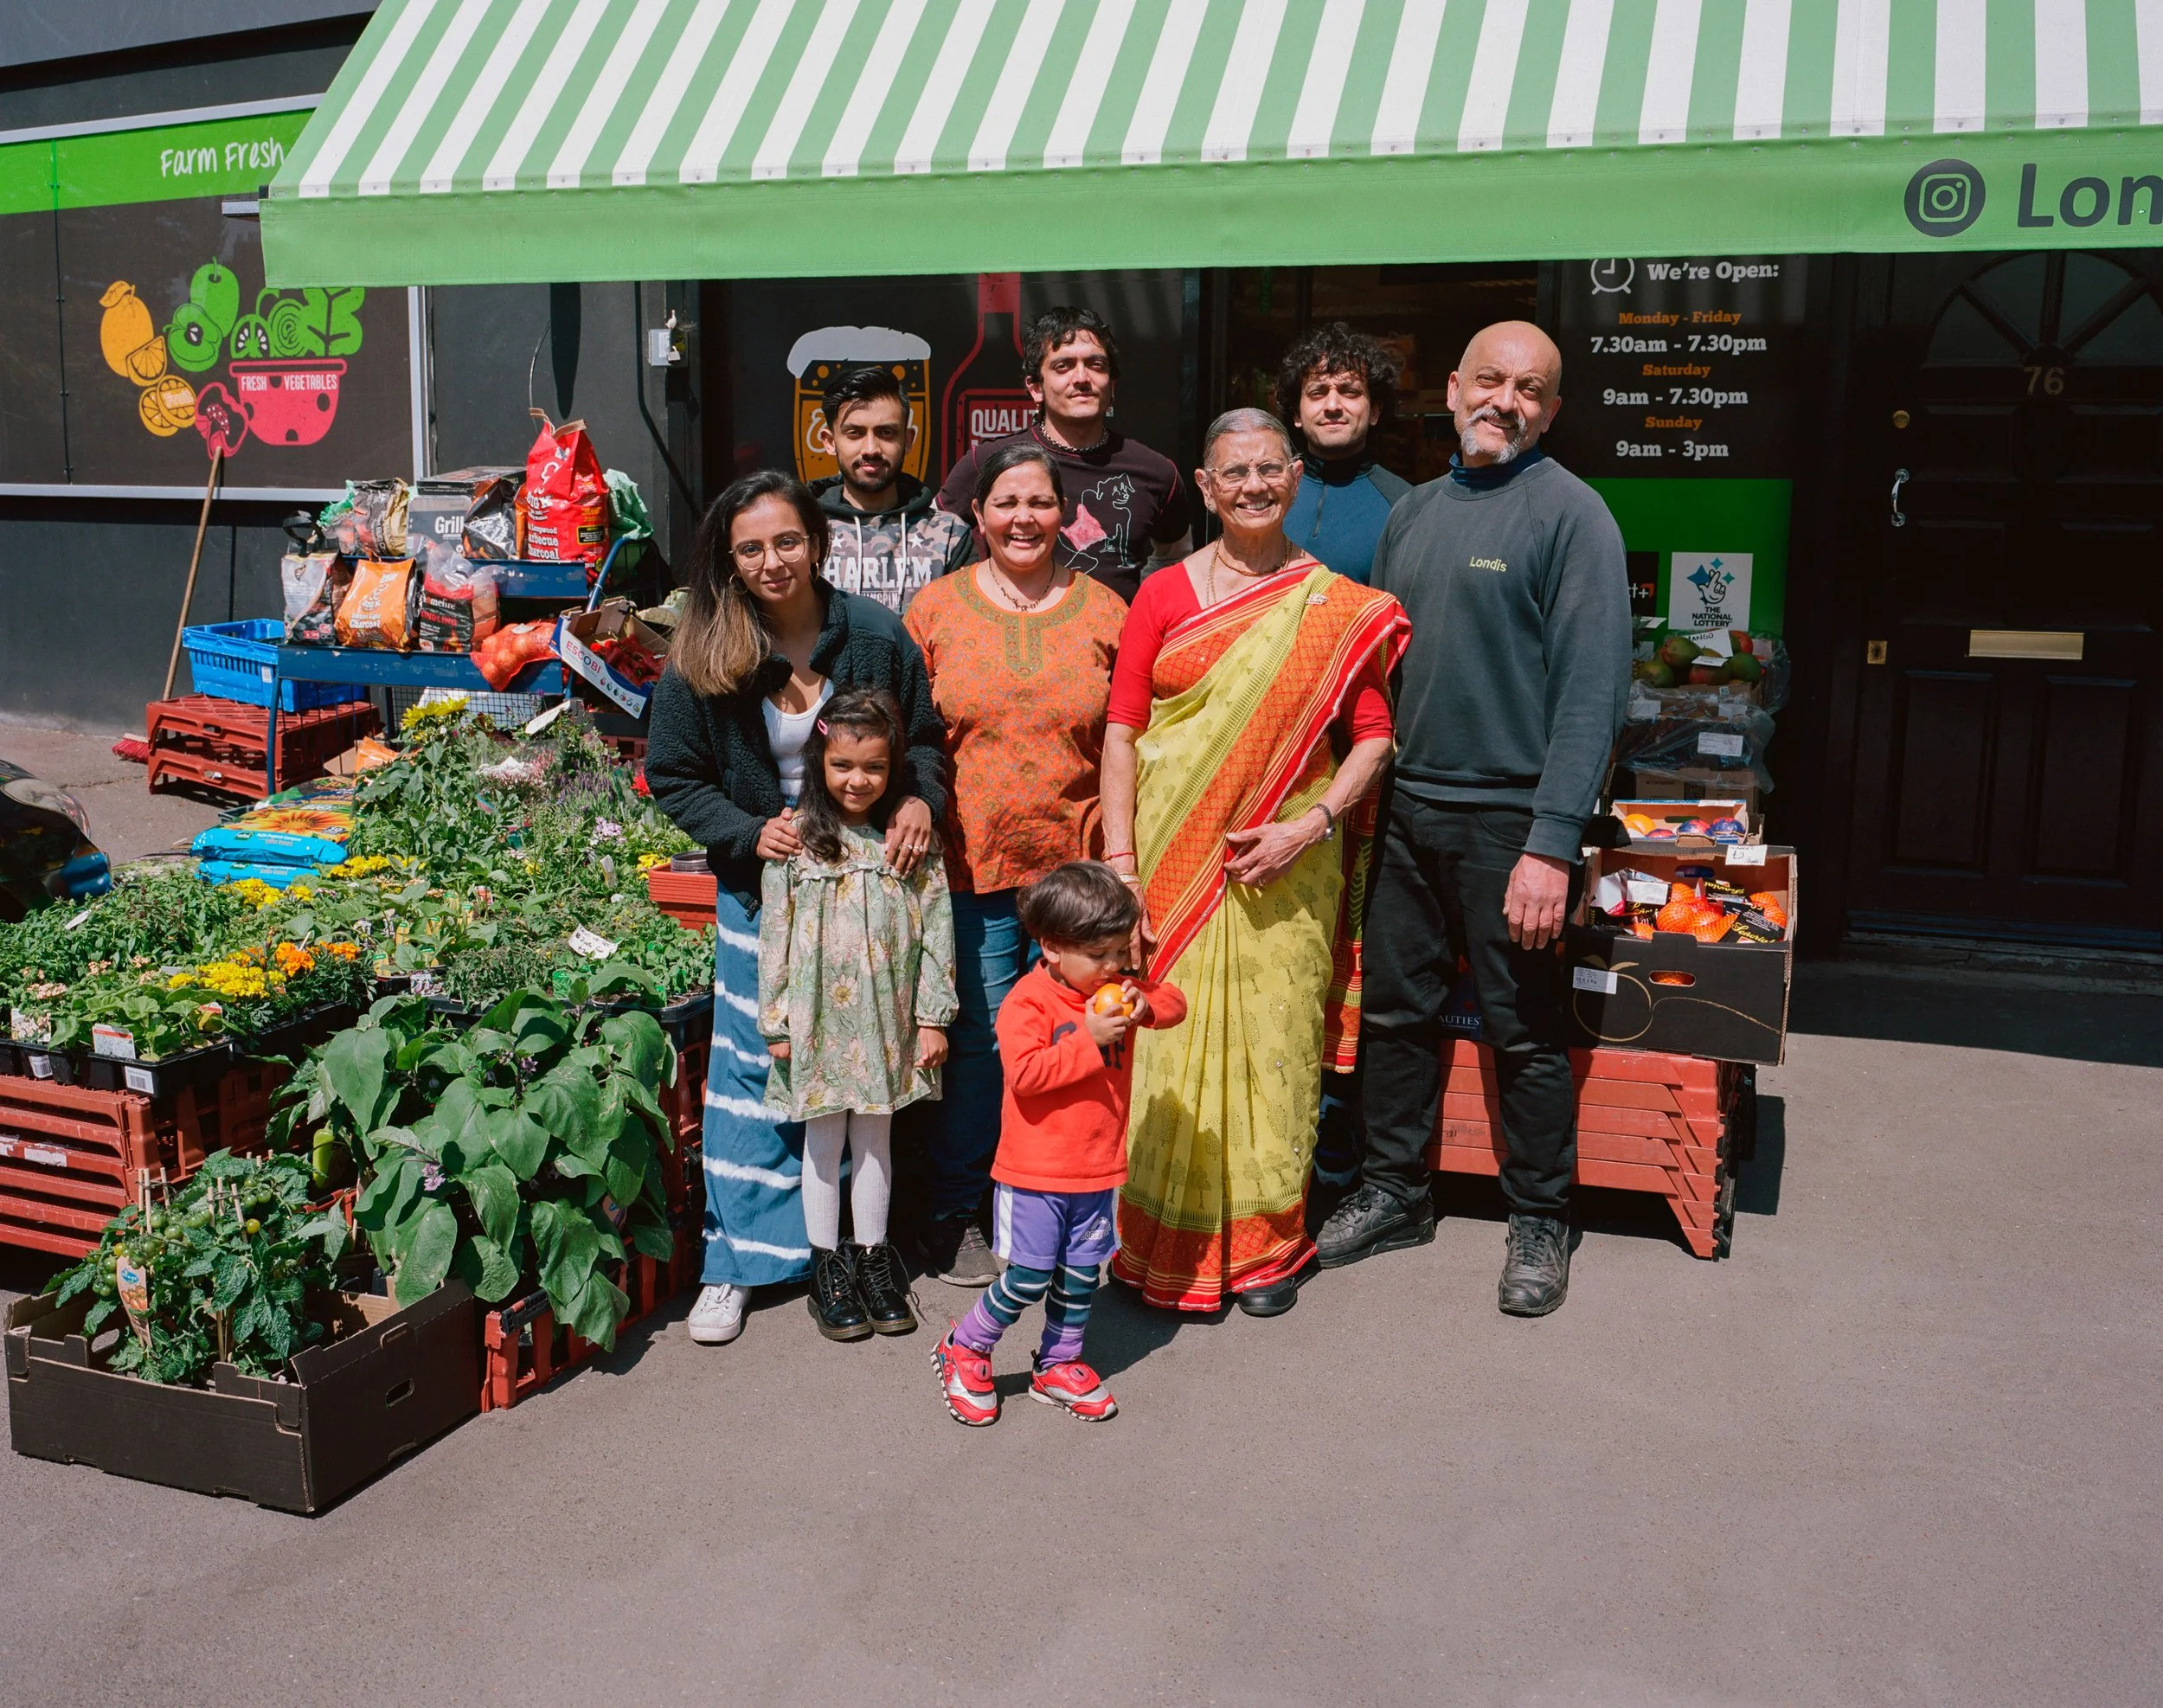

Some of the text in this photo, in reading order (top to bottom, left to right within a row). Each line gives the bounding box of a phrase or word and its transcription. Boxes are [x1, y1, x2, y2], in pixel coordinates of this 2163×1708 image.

[161, 137, 284, 177] Farm Fresh
[1716, 260, 1780, 283] Open:
[1618, 311, 1679, 327] Monday
[1691, 311, 1743, 326] Friday
[1590, 336, 1667, 353] 7.30am
[1688, 334, 1767, 356] 7.30pm
[1642, 363, 1711, 378] Saturday
[241, 373, 337, 391] FRESH VEGETABLES
[2023, 367, 2065, 396] 76
[1602, 388, 1649, 406] 9am
[1669, 388, 1749, 408] 7.30pm
[1645, 416, 1703, 432] Sunday
[1615, 440, 1662, 458] 9am
[1682, 440, 1729, 461] 3pm
[434, 516, 464, 534] Grill
[528, 532, 559, 547] arbecue
[823, 556, 933, 588] HARLEM
[1468, 556, 1508, 573] Londis
[566, 640, 602, 674] ESCOBI
